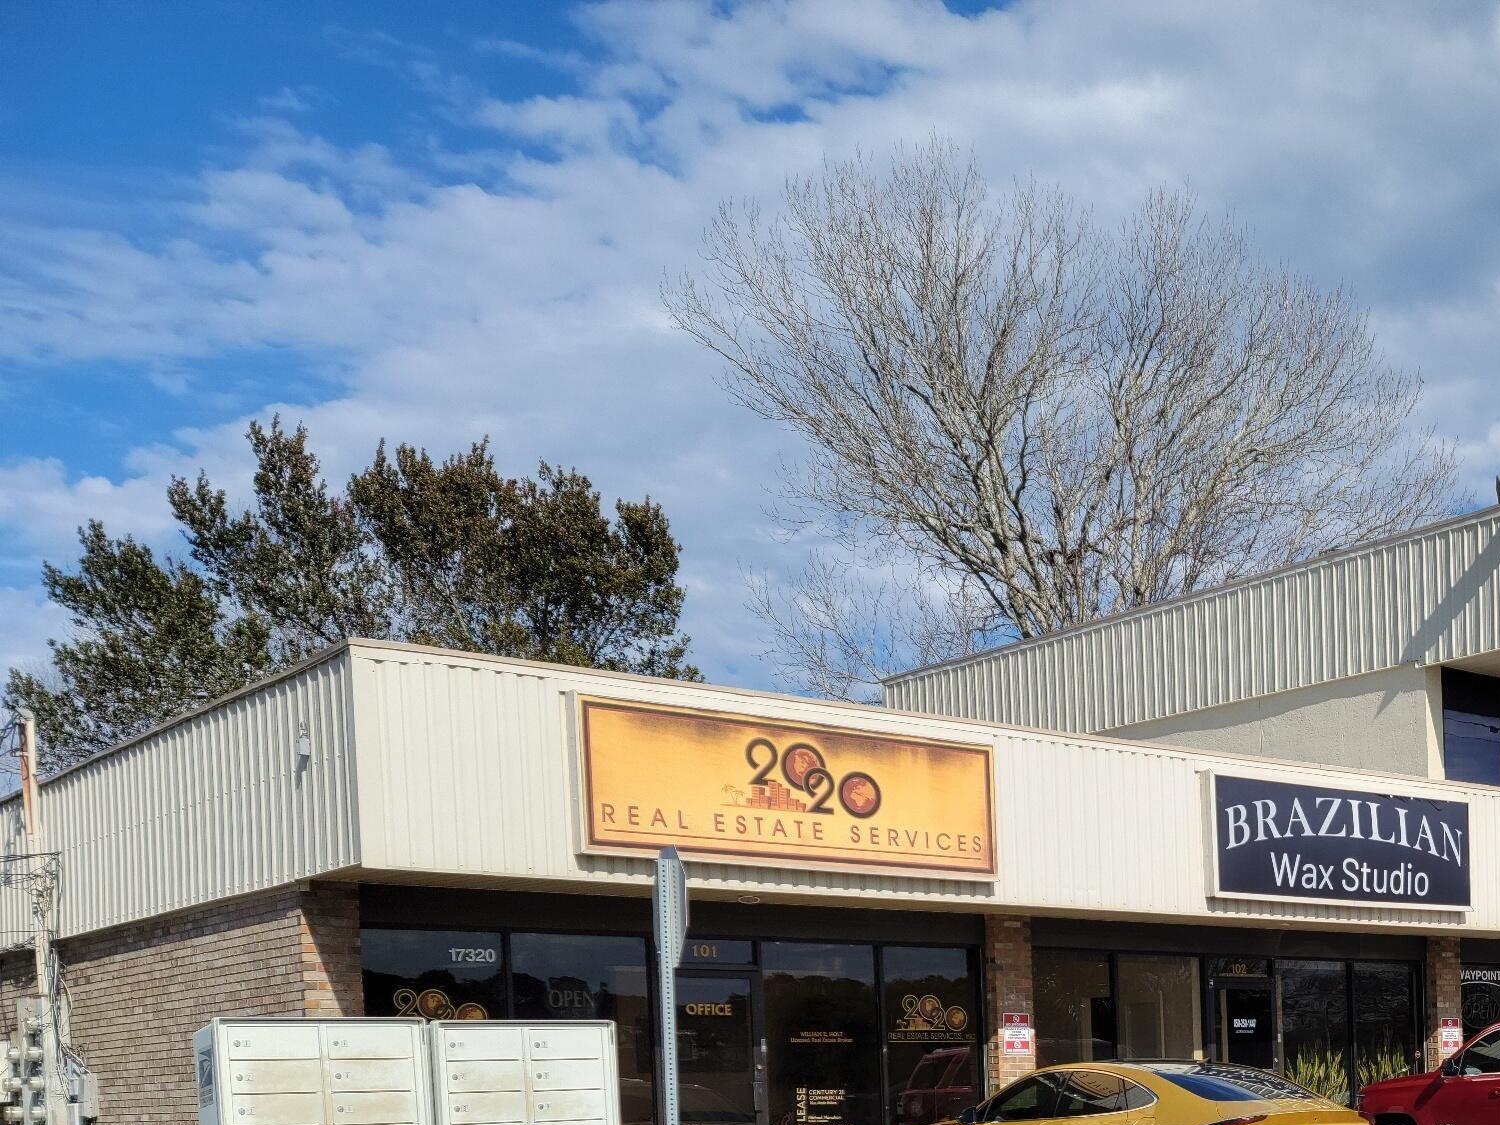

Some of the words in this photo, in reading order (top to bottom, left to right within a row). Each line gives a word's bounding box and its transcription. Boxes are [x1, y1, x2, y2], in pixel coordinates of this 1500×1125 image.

[602, 803, 689, 830] REAL
[714, 813, 824, 841] ESTATE
[850, 824, 983, 853] SERVICES
[1225, 795, 1463, 868] BRAZILIAN
[1270, 851, 1333, 890] Wax
[1342, 857, 1429, 897] Studio
[449, 947, 496, 963] 17320
[692, 945, 718, 958] 101
[549, 990, 596, 1008] OPEN
[686, 1003, 734, 1016] OFFICE
[888, 1032, 905, 1040] REAL
[906, 1032, 929, 1040] ESTATE
[796, 1087, 806, 1122] LEASE
